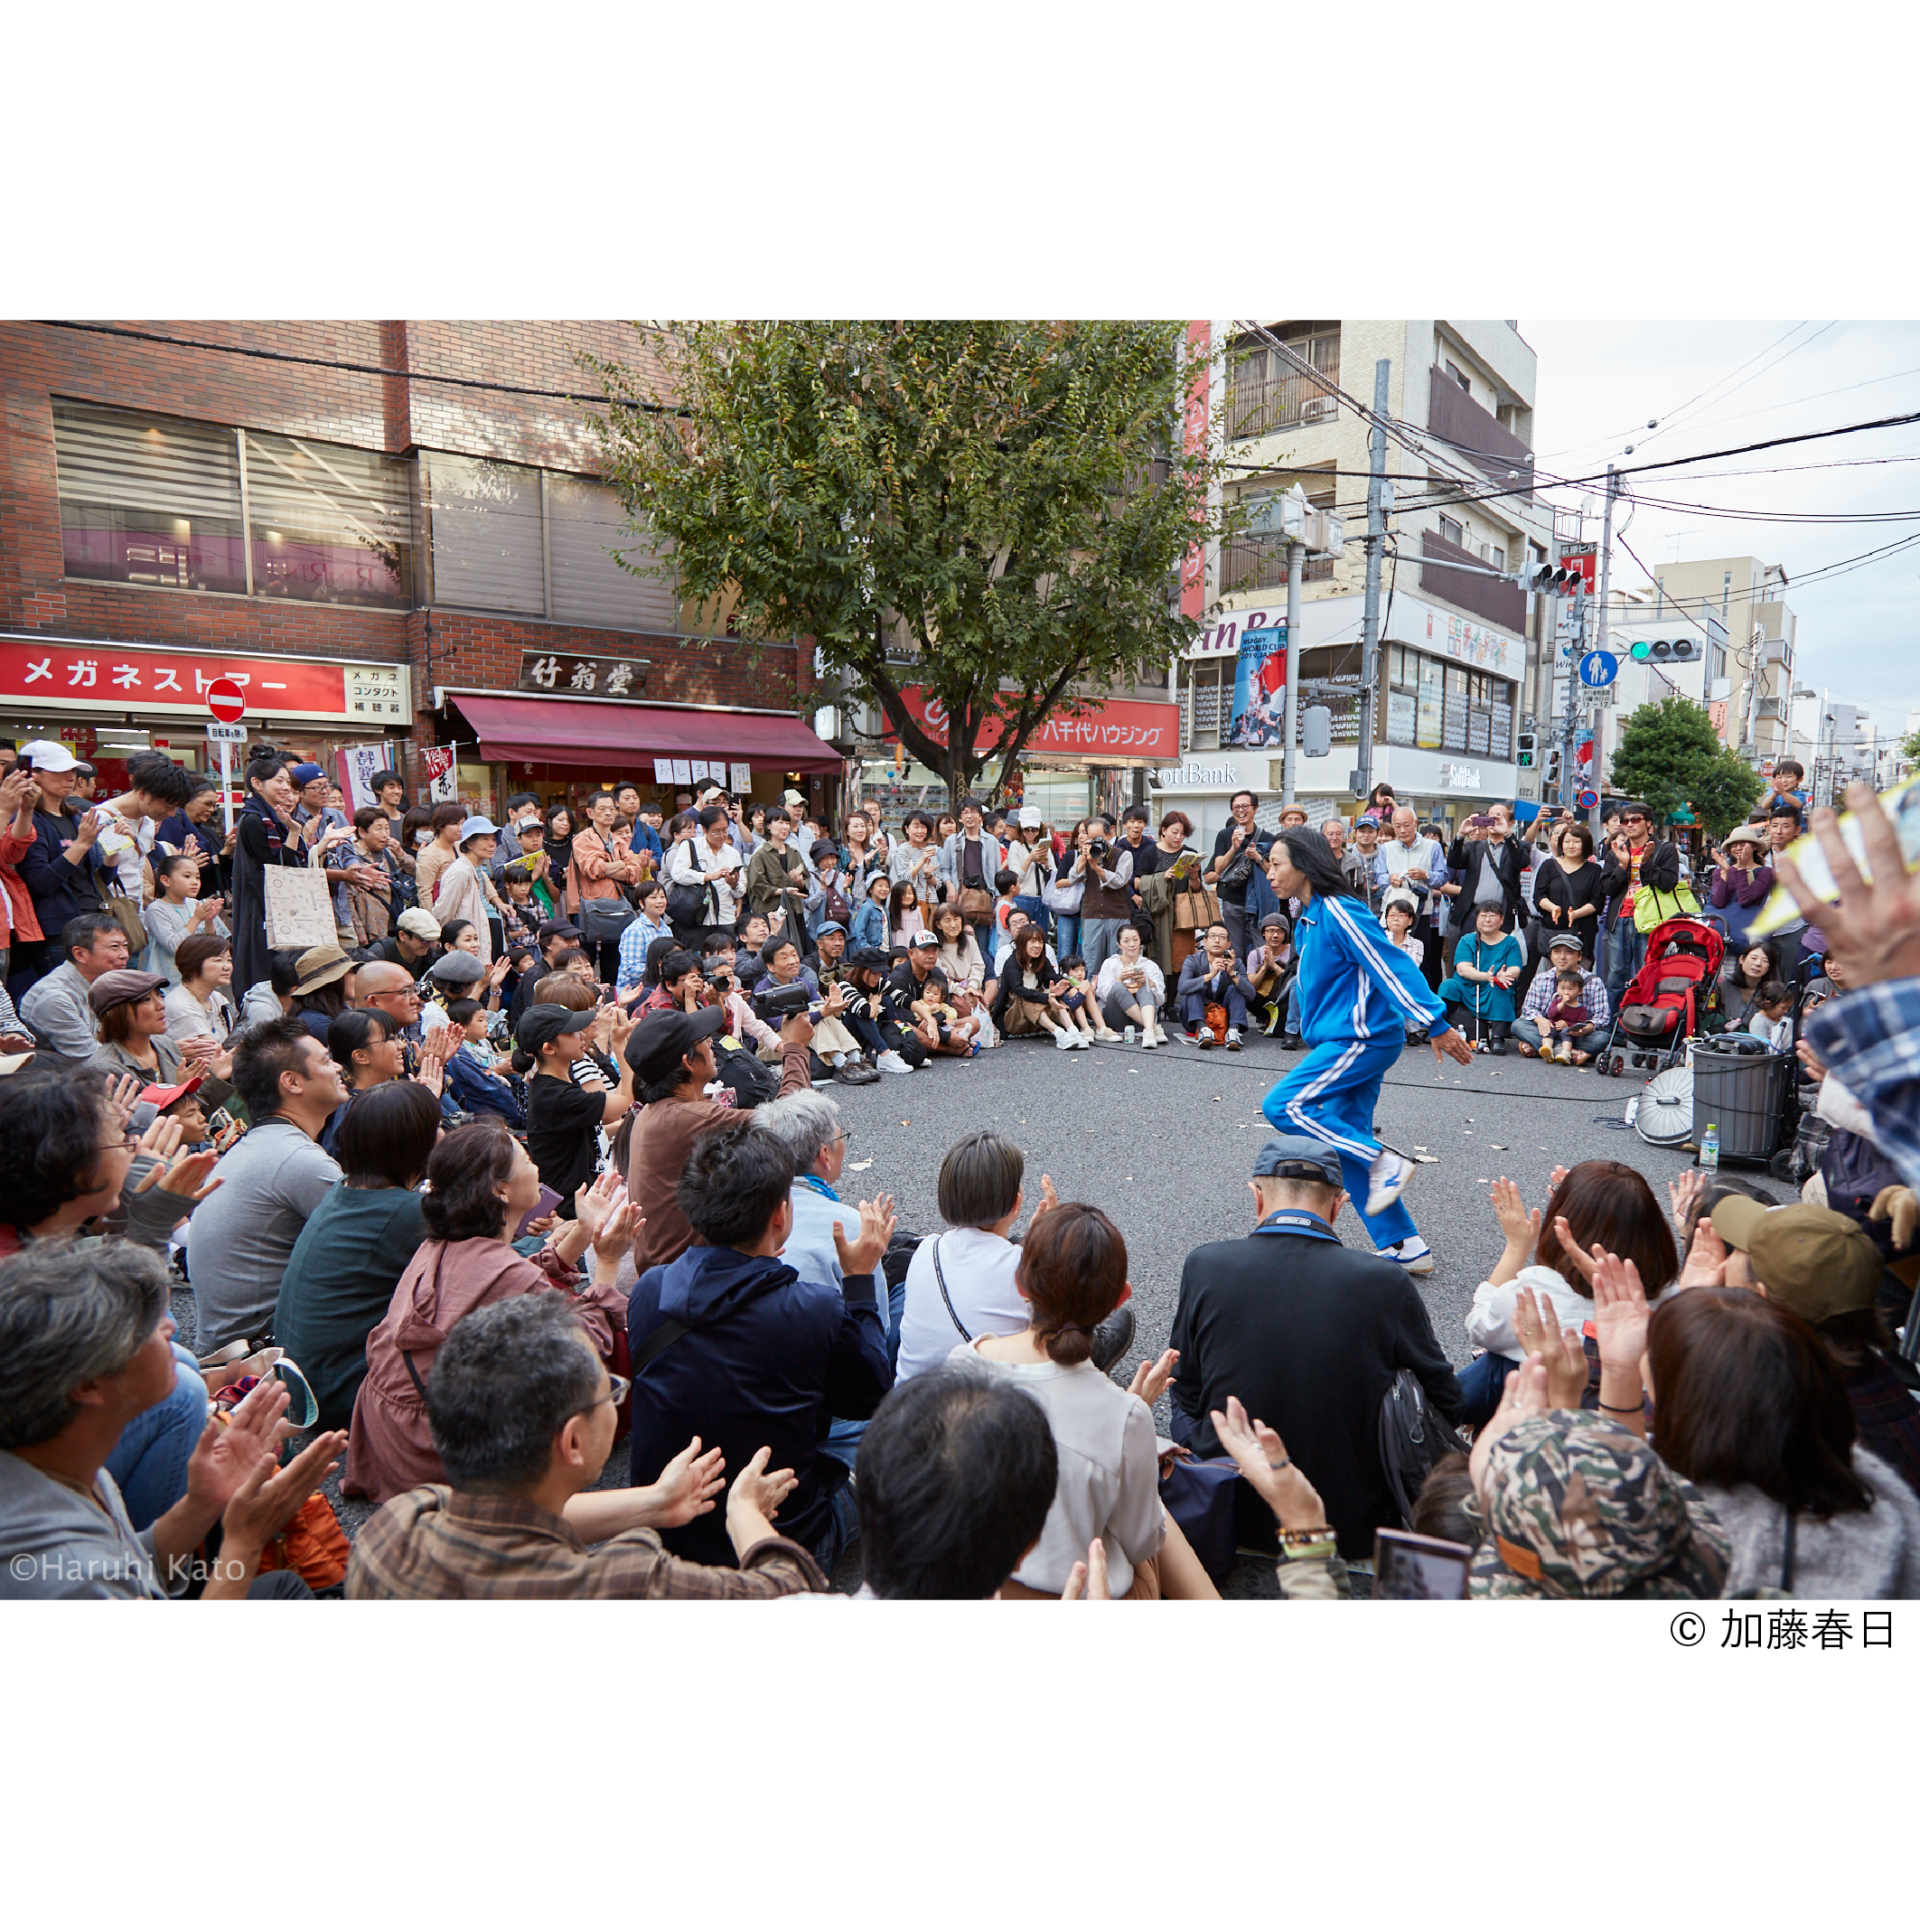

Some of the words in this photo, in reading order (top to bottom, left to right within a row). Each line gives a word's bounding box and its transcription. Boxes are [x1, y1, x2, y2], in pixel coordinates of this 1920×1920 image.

[1243, 637, 1267, 645] RUGBY
[1242, 644, 1268, 653] WORLD
[1269, 643, 1286, 651] CUP
[353, 671, 398, 682] メガネ
[531, 655, 634, 695] 竹翁堂
[354, 686, 399, 698] コンタクト
[355, 702, 400, 714] 補聴器
[212, 728, 245, 740] 自転車を除く
[1042, 719, 1164, 746] 八千代ハウジング
[1161, 762, 1236, 785] oftBank
